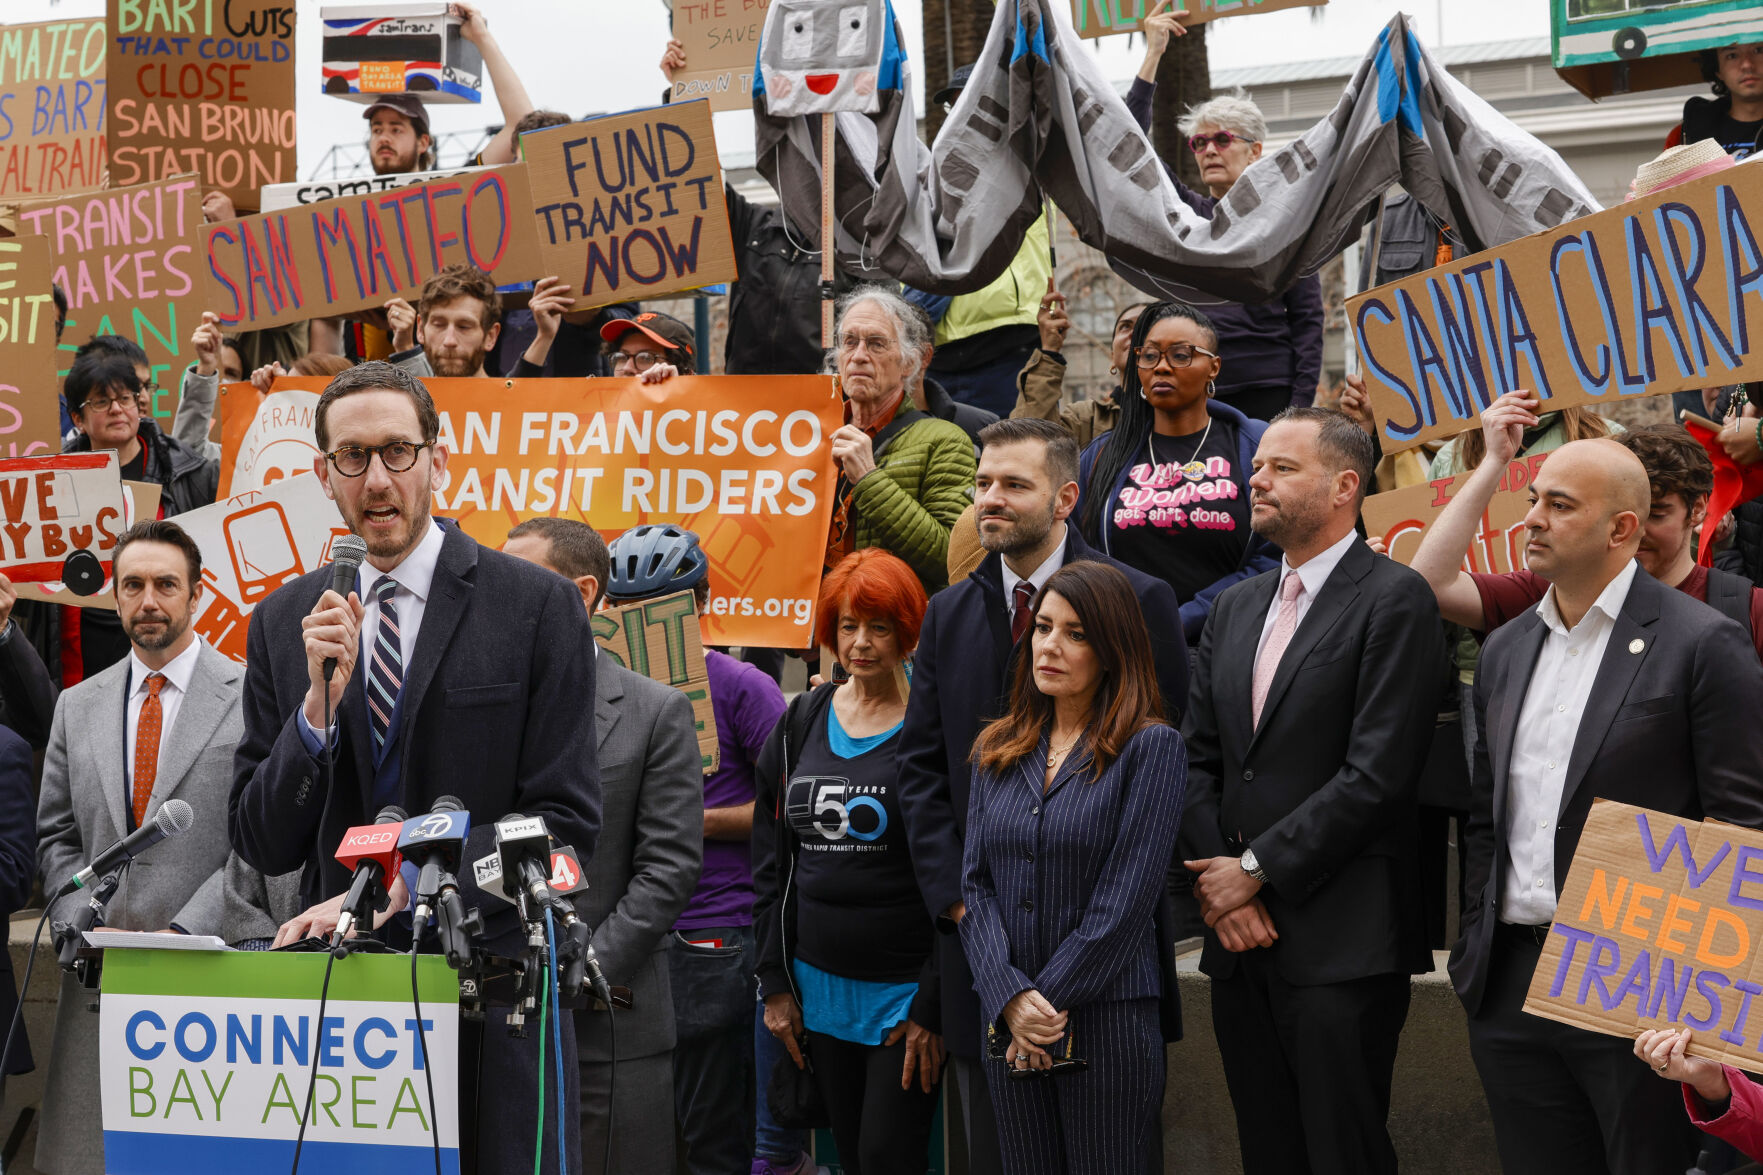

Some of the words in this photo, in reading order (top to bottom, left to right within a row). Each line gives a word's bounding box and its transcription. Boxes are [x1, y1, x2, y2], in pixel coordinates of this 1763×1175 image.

[378, 20, 434, 34] samTrans
[680, 0, 727, 24] THE
[707, 23, 757, 49] SAVE
[116, 36, 190, 56] THAT
[198, 38, 290, 63] COULD
[136, 62, 252, 102] CLOSE
[675, 72, 731, 97] DOWN
[114, 99, 190, 139] SAN
[199, 103, 296, 149] BRUNO
[0, 135, 108, 195] ALTRAIN
[112, 147, 282, 190] STATION
[562, 122, 695, 198] FUND
[20, 180, 195, 255] TRANSIT
[534, 175, 713, 245] TRANSIT
[207, 213, 304, 326] SAN
[311, 171, 511, 304] MATEO
[582, 215, 703, 296] NOW
[1356, 258, 1553, 442] SANTA
[1549, 184, 1763, 396] CLARA
[437, 410, 501, 455] AN
[518, 409, 822, 458] FRANCISCO
[622, 468, 817, 516] RIDERS
[1119, 479, 1235, 509] Women
[41, 507, 119, 557] BUS
[1114, 507, 1143, 526] get
[1190, 507, 1232, 527] done
[812, 785, 888, 842] 50
[848, 785, 887, 795] YEARS
[347, 832, 393, 847] KQED
[409, 828, 427, 838] abc
[504, 824, 537, 834] KPIX
[829, 844, 854, 852] TRANSIT
[476, 857, 500, 876] NB
[550, 855, 576, 887] 4
[1635, 813, 1763, 911] WE
[1578, 868, 1750, 969] NEED
[1548, 922, 1763, 1053] TRANSI
[125, 1009, 434, 1071] CONNECT
[128, 1066, 234, 1122] BAY
[261, 1072, 430, 1132] AREA
